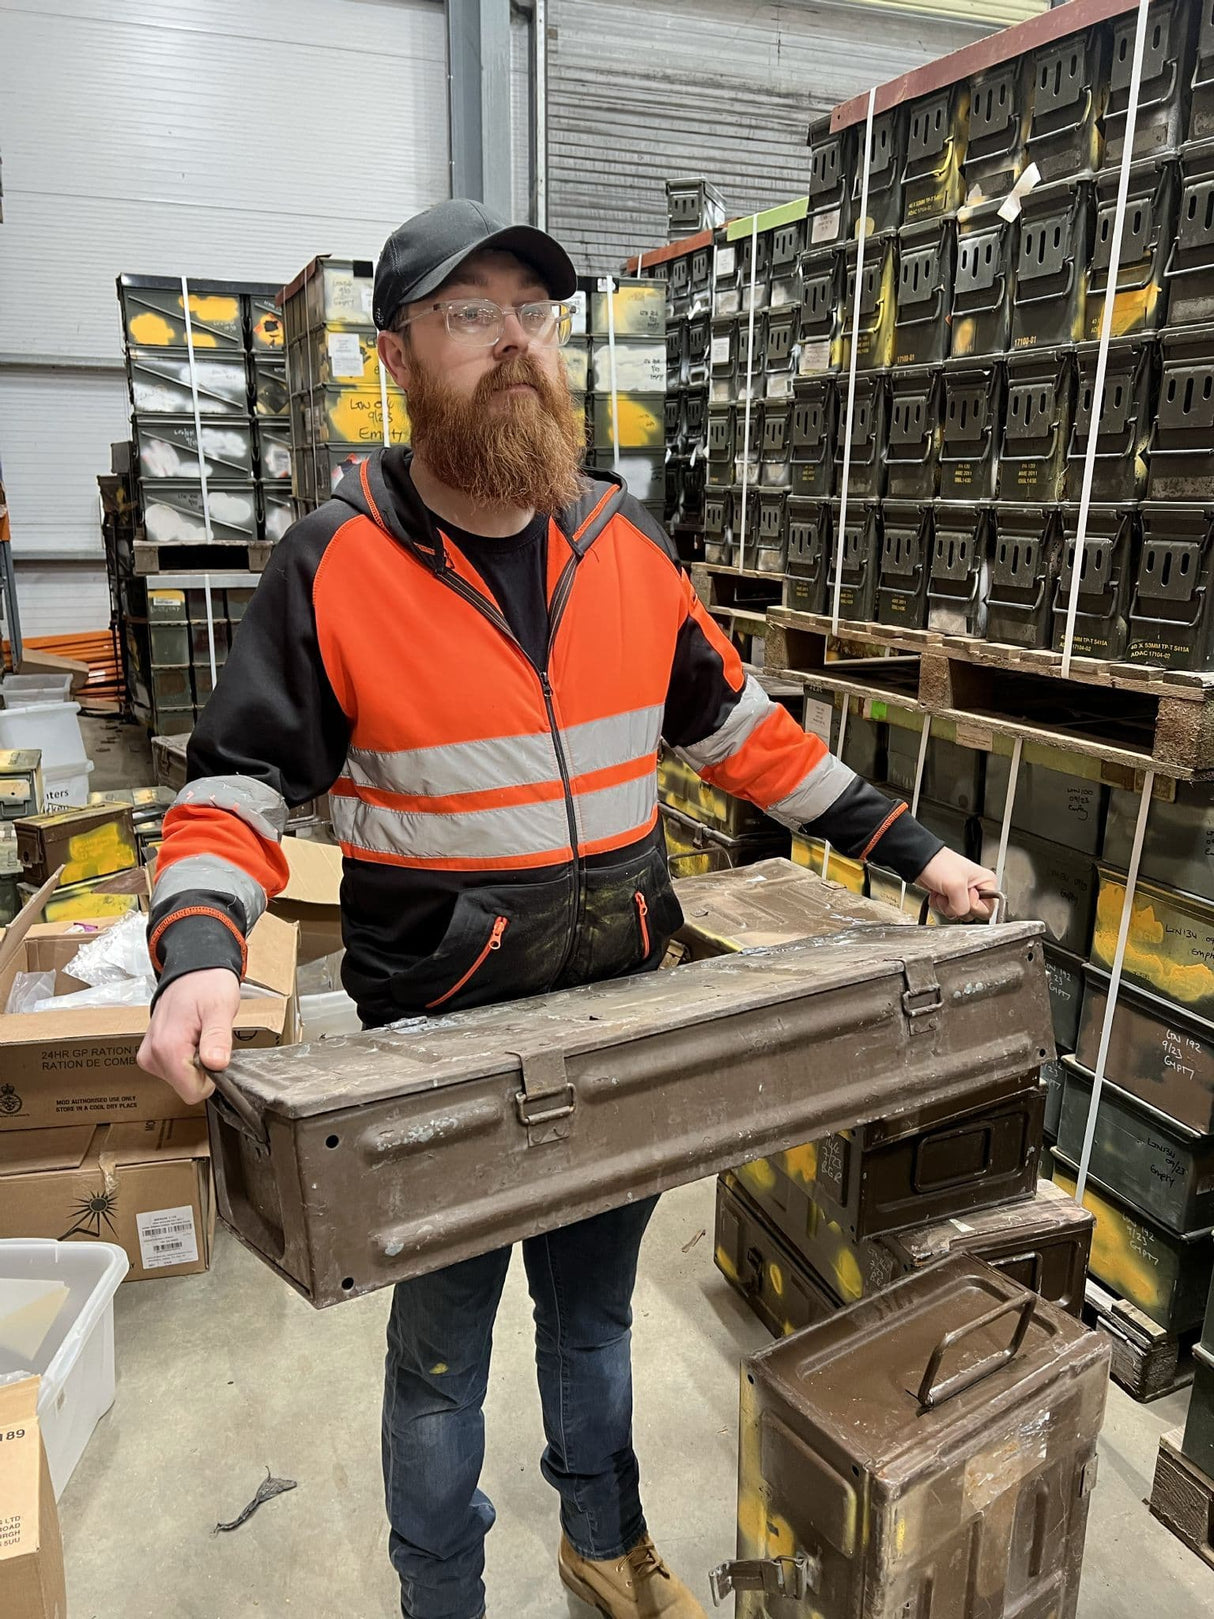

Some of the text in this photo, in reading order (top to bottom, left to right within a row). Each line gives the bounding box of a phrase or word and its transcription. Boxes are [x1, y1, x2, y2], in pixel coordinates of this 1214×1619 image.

[359, 426, 403, 443] Emty
[41, 1050, 70, 1060] 24HR
[72, 1048, 89, 1058] GP
[91, 1046, 132, 1057] RATION
[1161, 1040, 1183, 1059] 9/23
[1185, 1038, 1202, 1054] 192
[42, 1057, 137, 1070] RATION DE COMB
[4, 1515, 21, 1524] LTD
